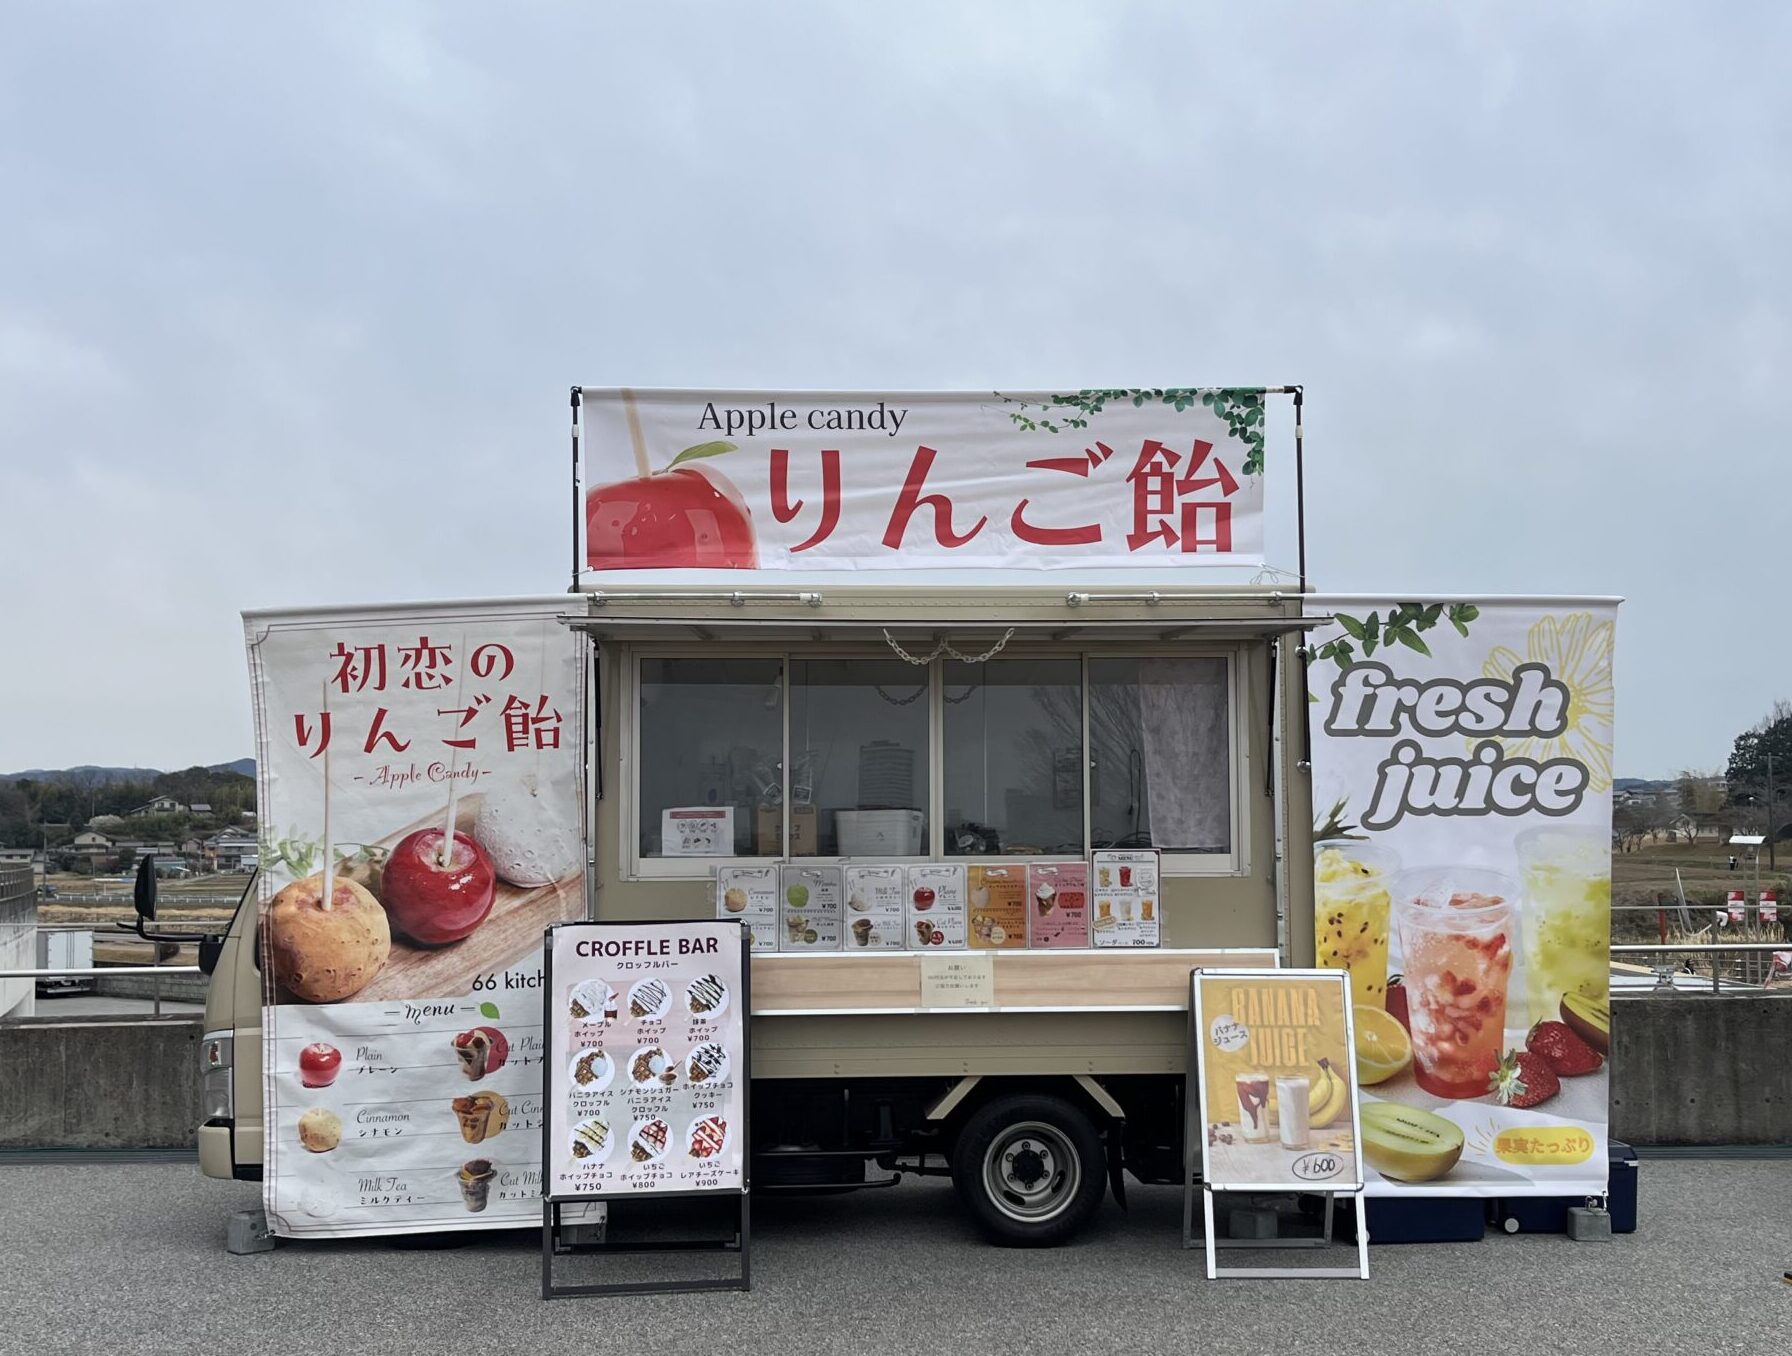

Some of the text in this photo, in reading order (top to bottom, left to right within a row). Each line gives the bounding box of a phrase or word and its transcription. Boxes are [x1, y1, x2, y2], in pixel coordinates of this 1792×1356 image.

[697, 402, 909, 437] Apple candy
[769, 438, 1239, 553] りんご飴
[329, 636, 515, 693] 初恋の
[1324, 660, 1570, 738] fresh
[294, 693, 563, 759] りんご飴
[369, 761, 479, 789] Apple Candy
[1360, 739, 1591, 832] juice
[575, 937, 718, 957] CROFFLE BAR
[617, 960, 679, 970] クロッフルバー
[472, 973, 497, 991] 66
[1231, 987, 1321, 1026] BANANA
[640, 1018, 663, 1026] チョコ
[520, 1035, 544, 1051] Plai
[687, 1034, 710, 1042] ¥700
[1213, 1031, 1248, 1046] ジュース
[356, 1046, 383, 1061] Plain
[1251, 1027, 1310, 1067] JUICE
[356, 1109, 410, 1124] Cinnamon
[498, 1102, 517, 1116] Cut
[577, 1109, 600, 1117] ¥700
[1496, 1136, 1590, 1154] 果実たっぷり
[358, 1177, 407, 1192] Milk Tea
[500, 1171, 519, 1187] Cut
[575, 1183, 602, 1191] ¥750
[632, 1181, 655, 1189] ¥800
[695, 1179, 718, 1187] ¥900
